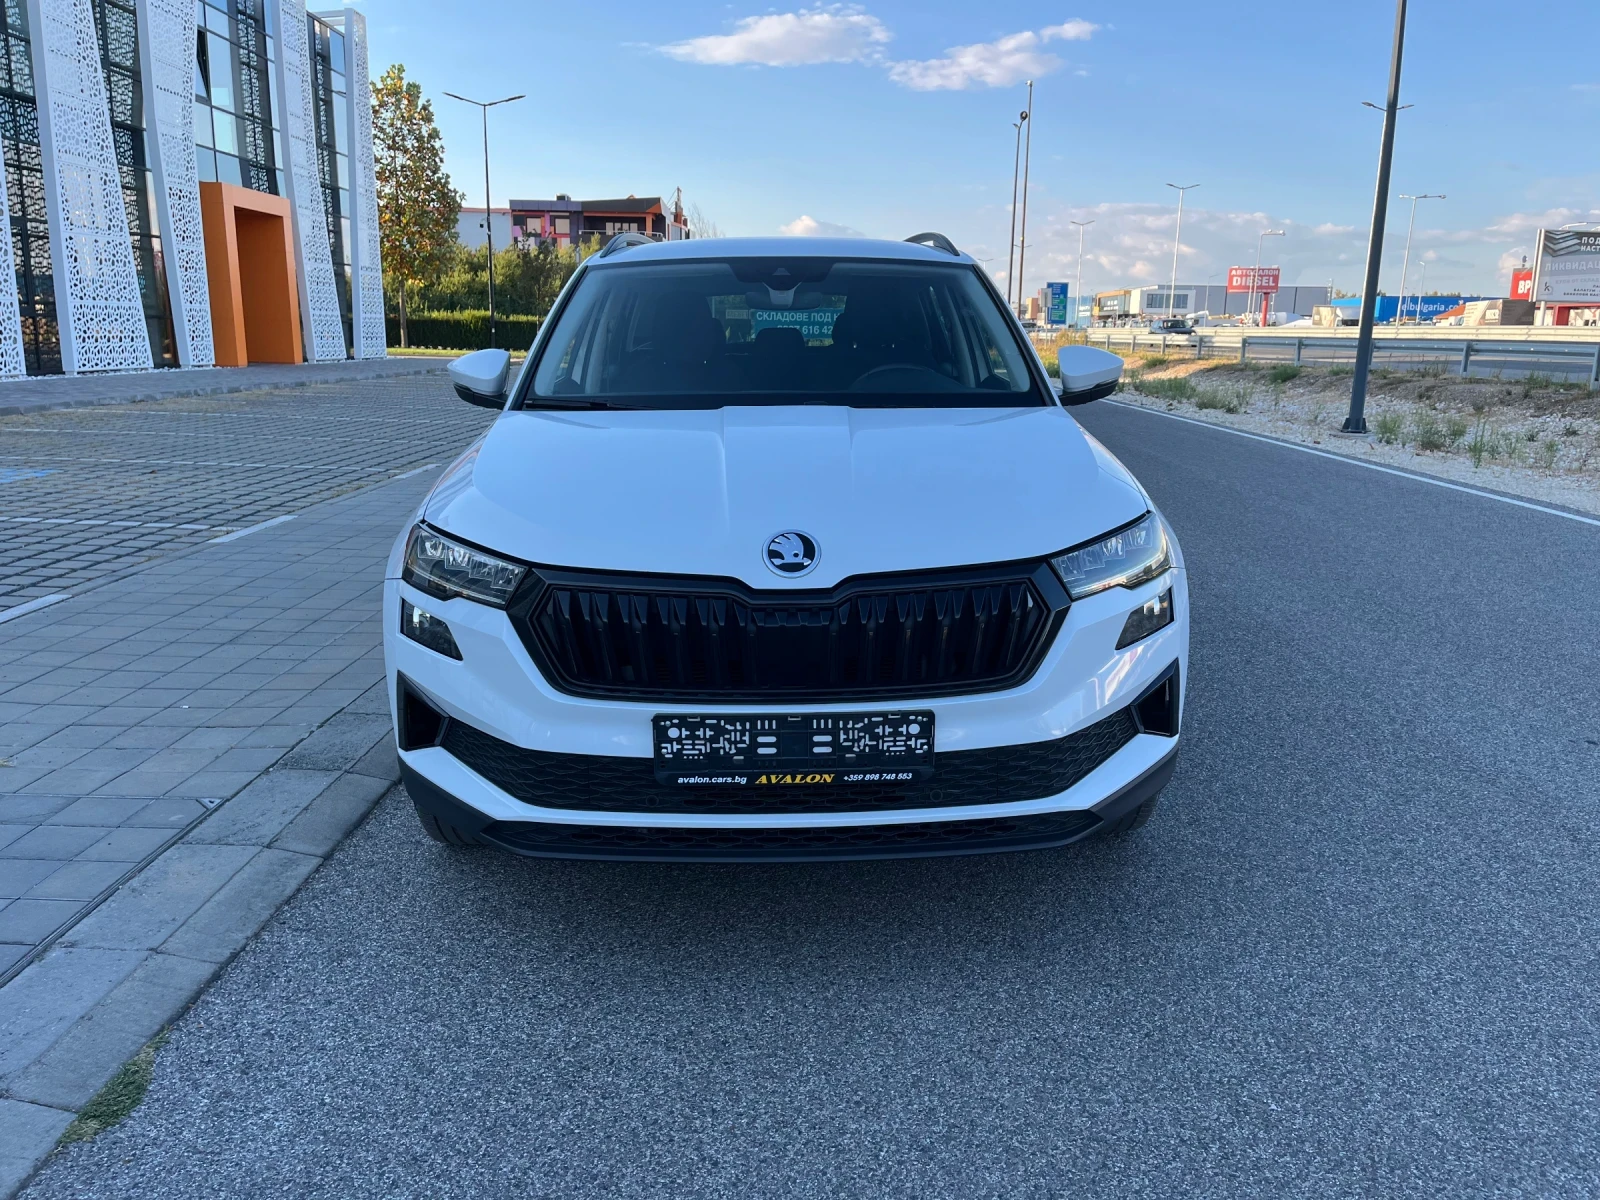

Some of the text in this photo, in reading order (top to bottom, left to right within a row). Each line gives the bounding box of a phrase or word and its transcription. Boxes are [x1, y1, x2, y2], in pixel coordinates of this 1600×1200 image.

[1232, 276, 1276, 286] DIESEL
[756, 312, 808, 322] СКЛАДОВЕ
[811, 313, 832, 322] ПОД
[802, 326, 820, 334] 616
[678, 776, 748, 784] avalon.cars.bg
[754, 774, 836, 784] AVALON
